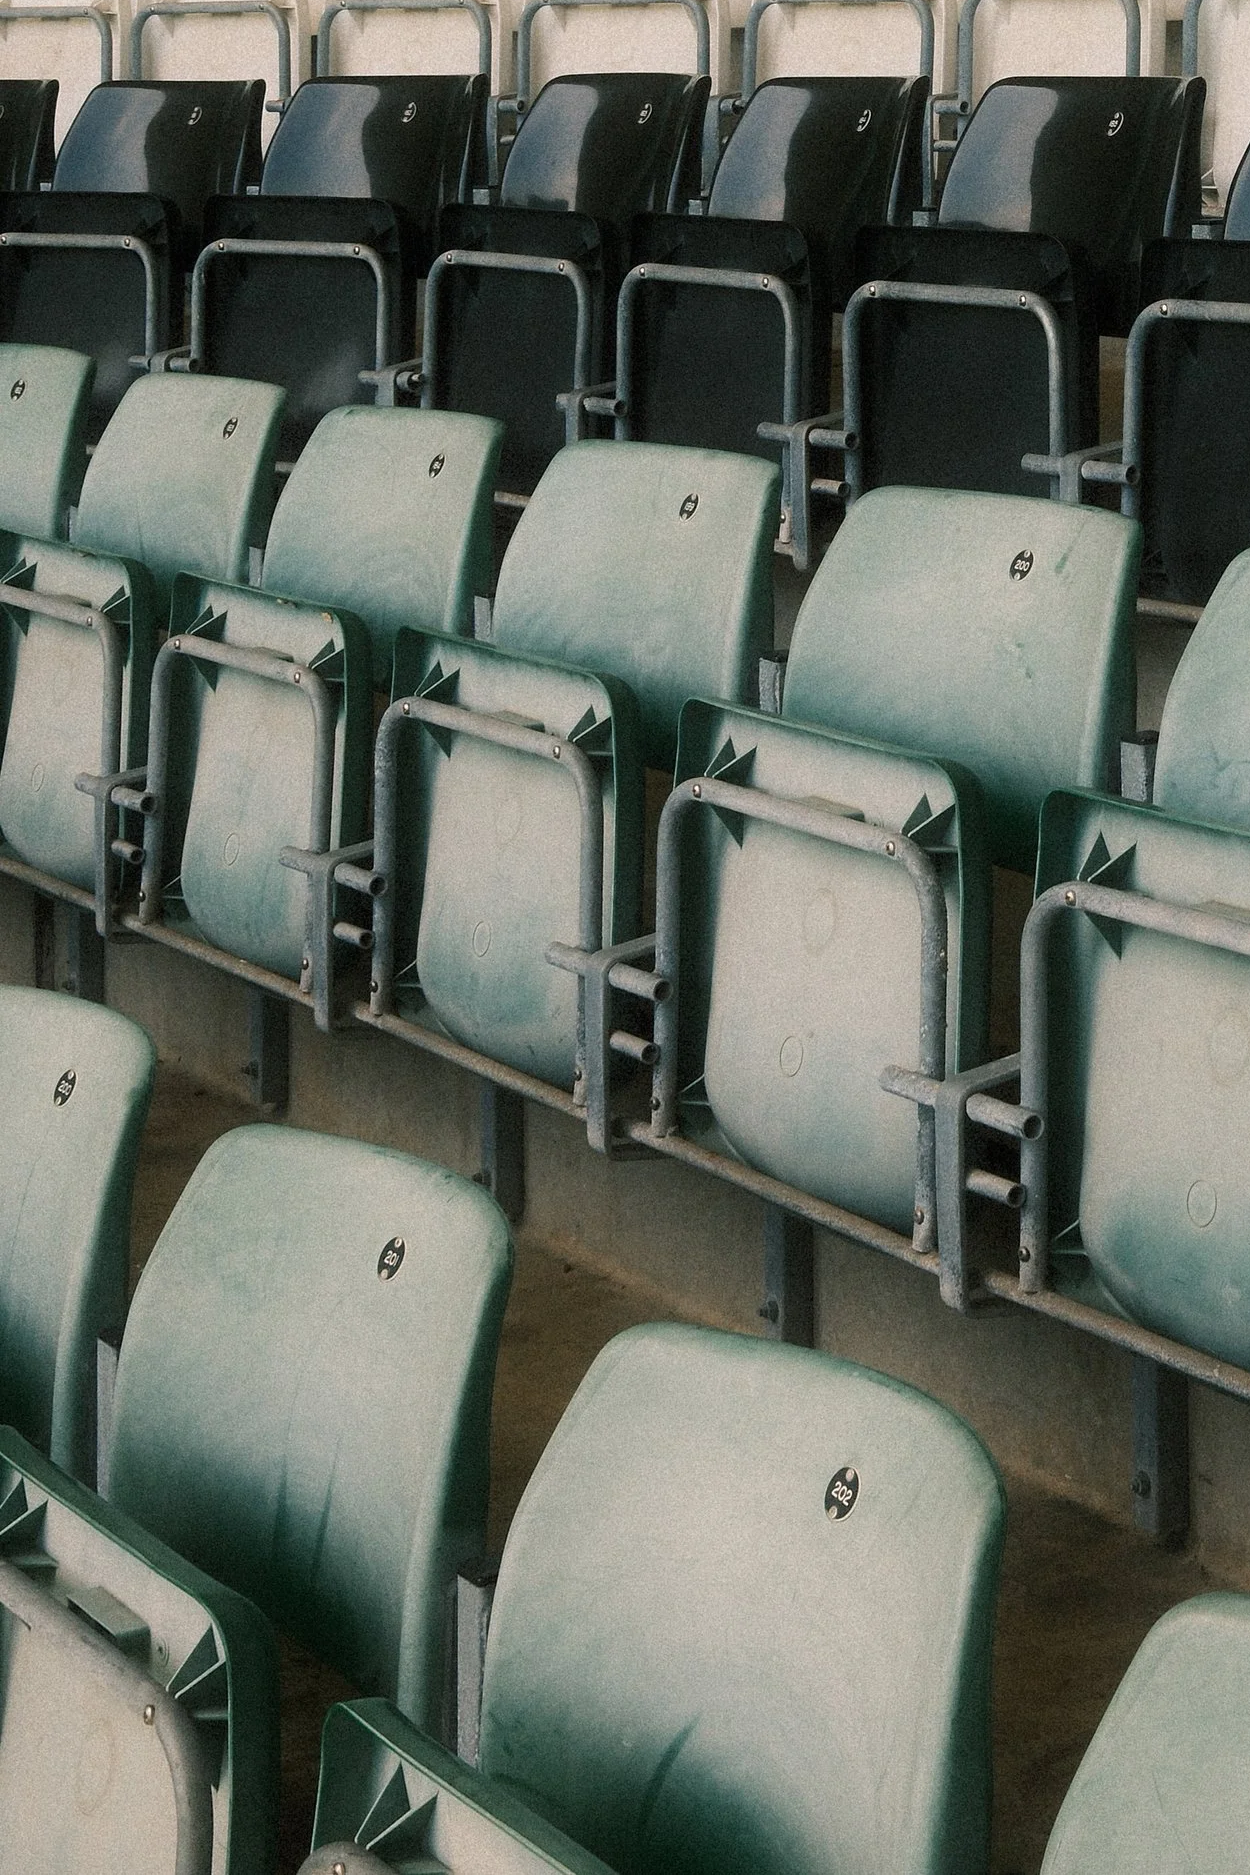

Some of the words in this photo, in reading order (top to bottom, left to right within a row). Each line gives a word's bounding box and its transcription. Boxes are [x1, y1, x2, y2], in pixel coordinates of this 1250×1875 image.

[1013, 558, 1031, 573] 200
[57, 1079, 73, 1096] 200
[383, 1249, 401, 1268] 201
[830, 1480, 854, 1508] 202
